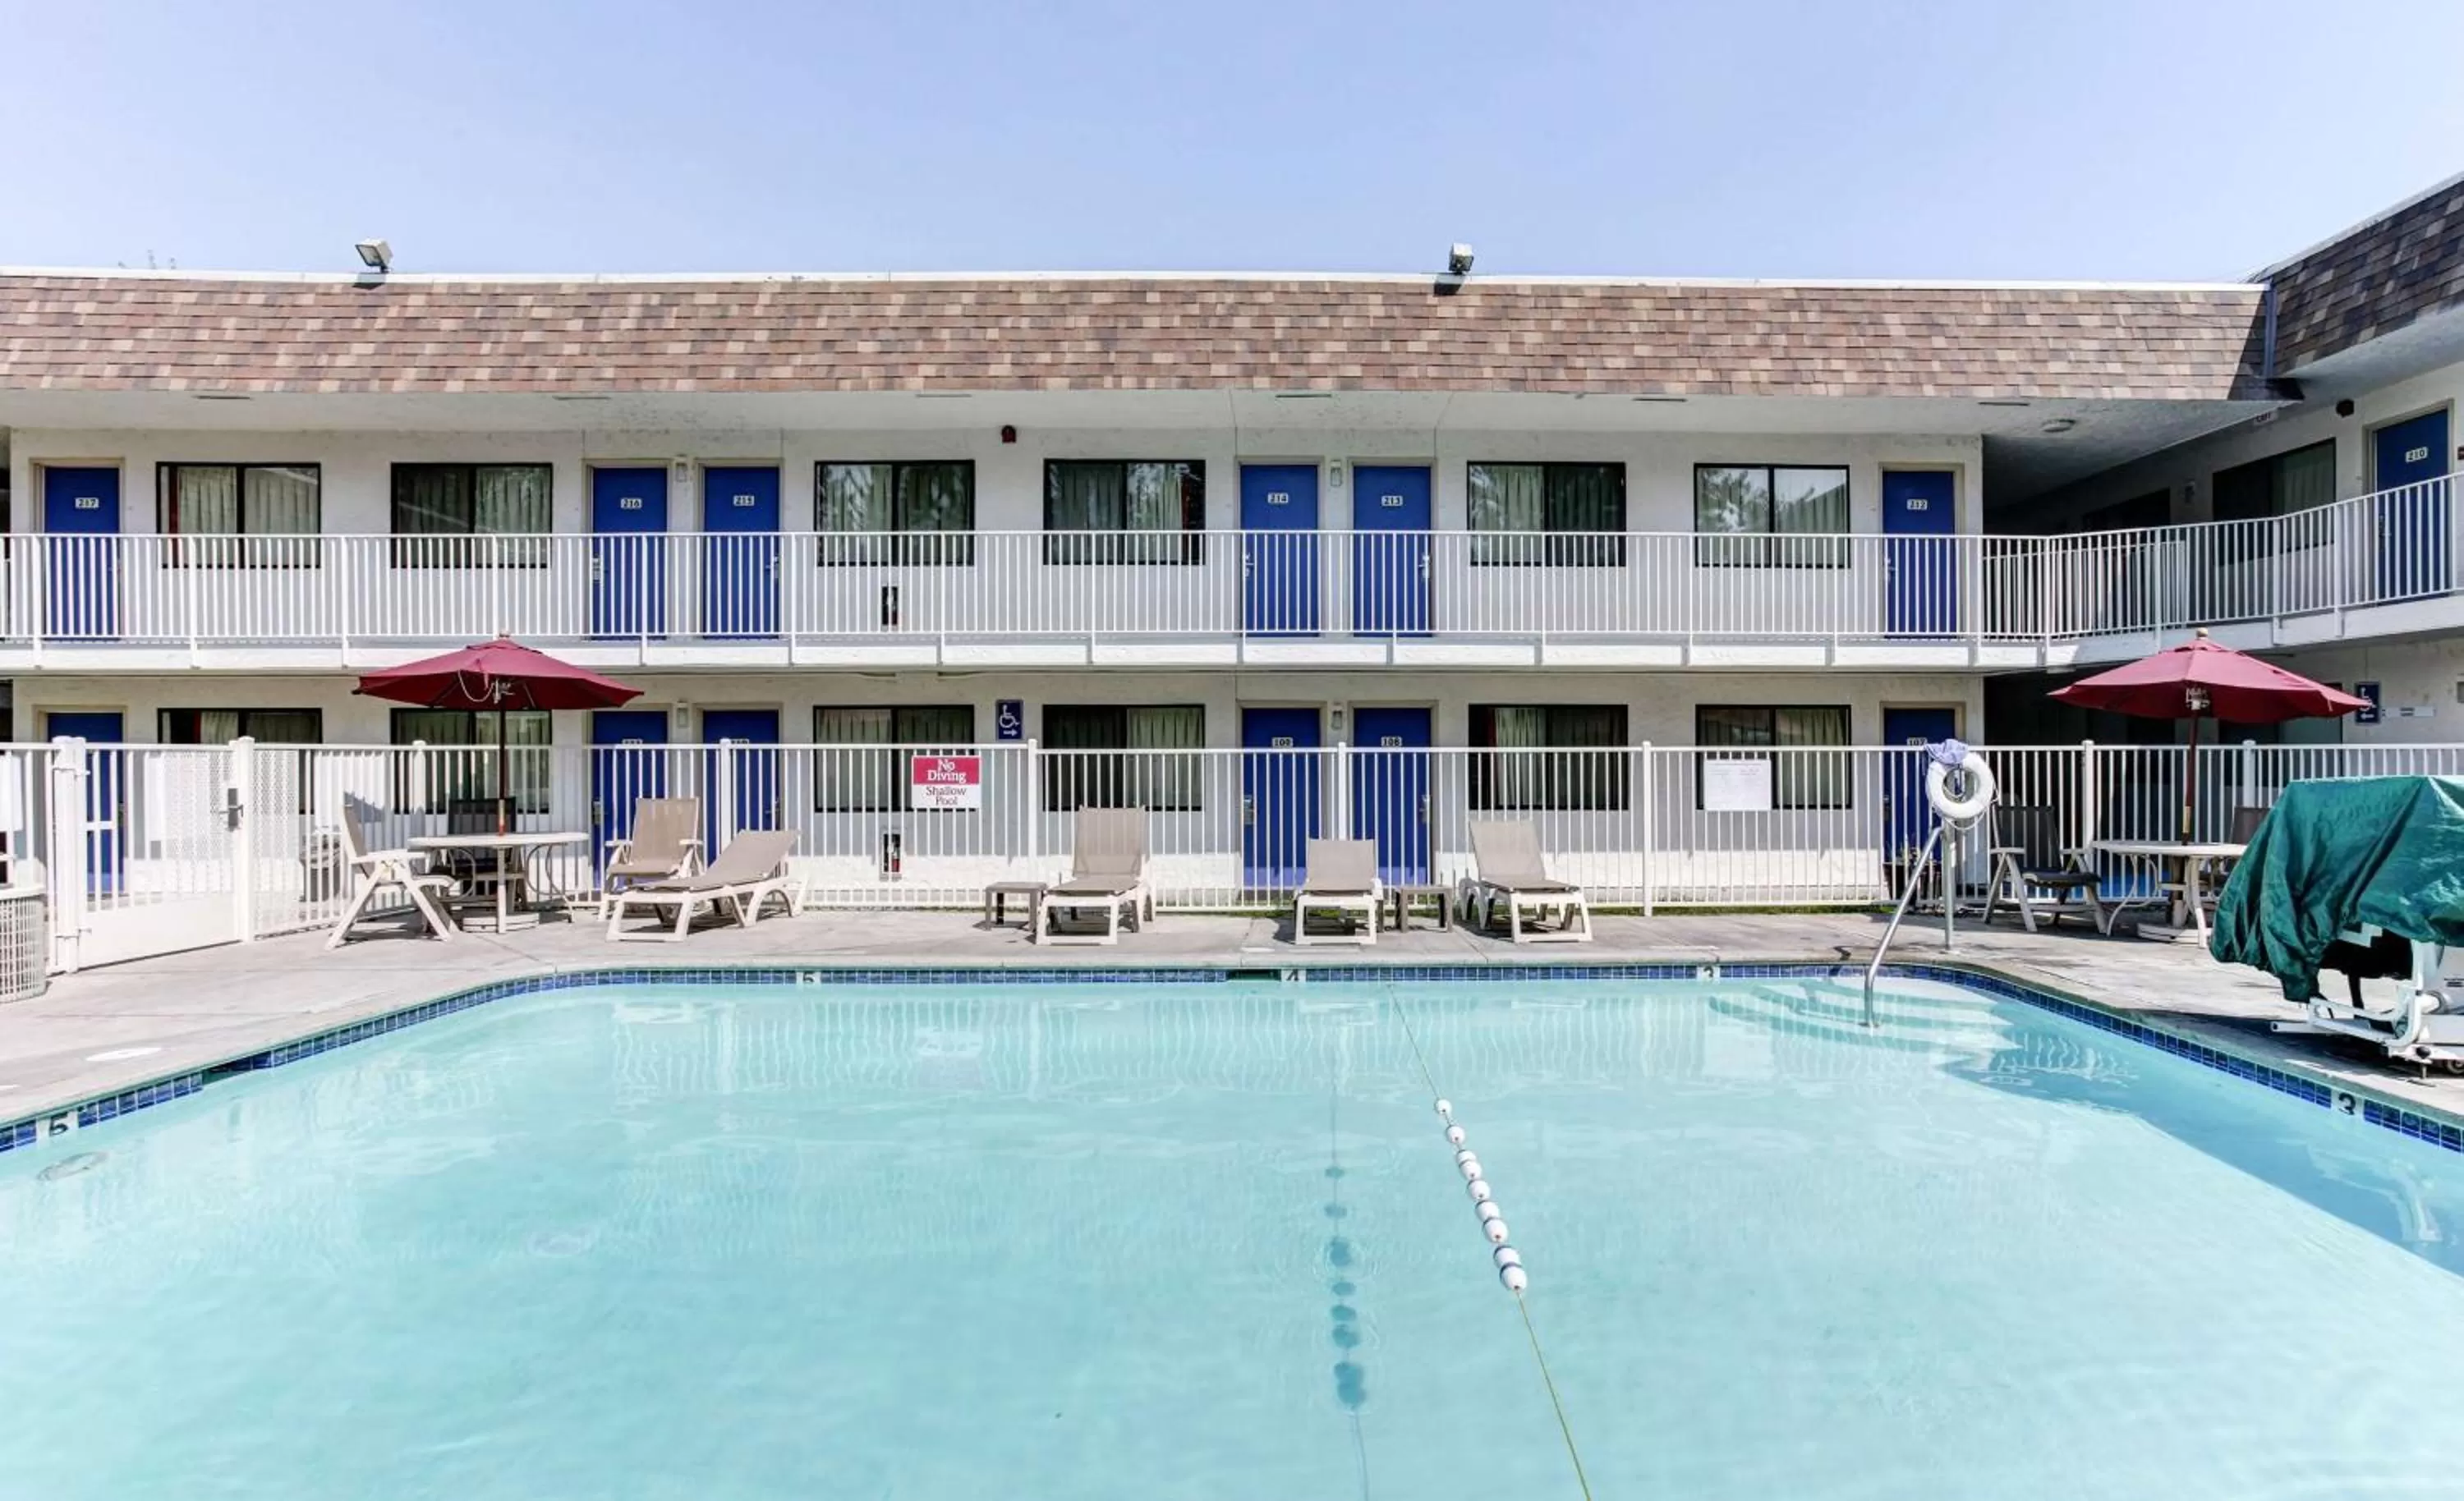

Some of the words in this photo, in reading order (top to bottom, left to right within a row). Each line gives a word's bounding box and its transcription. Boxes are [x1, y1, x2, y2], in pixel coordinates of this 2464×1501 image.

[2408, 449, 2426, 461] 210
[79, 498, 96, 507] 217
[623, 498, 639, 507] 216
[937, 758, 956, 772] No
[926, 769, 967, 784] Diving
[926, 786, 967, 796] Shallow
[935, 796, 958, 806] Pool
[802, 971, 815, 984] 5
[2338, 1093, 2356, 1116] 3
[49, 1111, 69, 1136] 5
